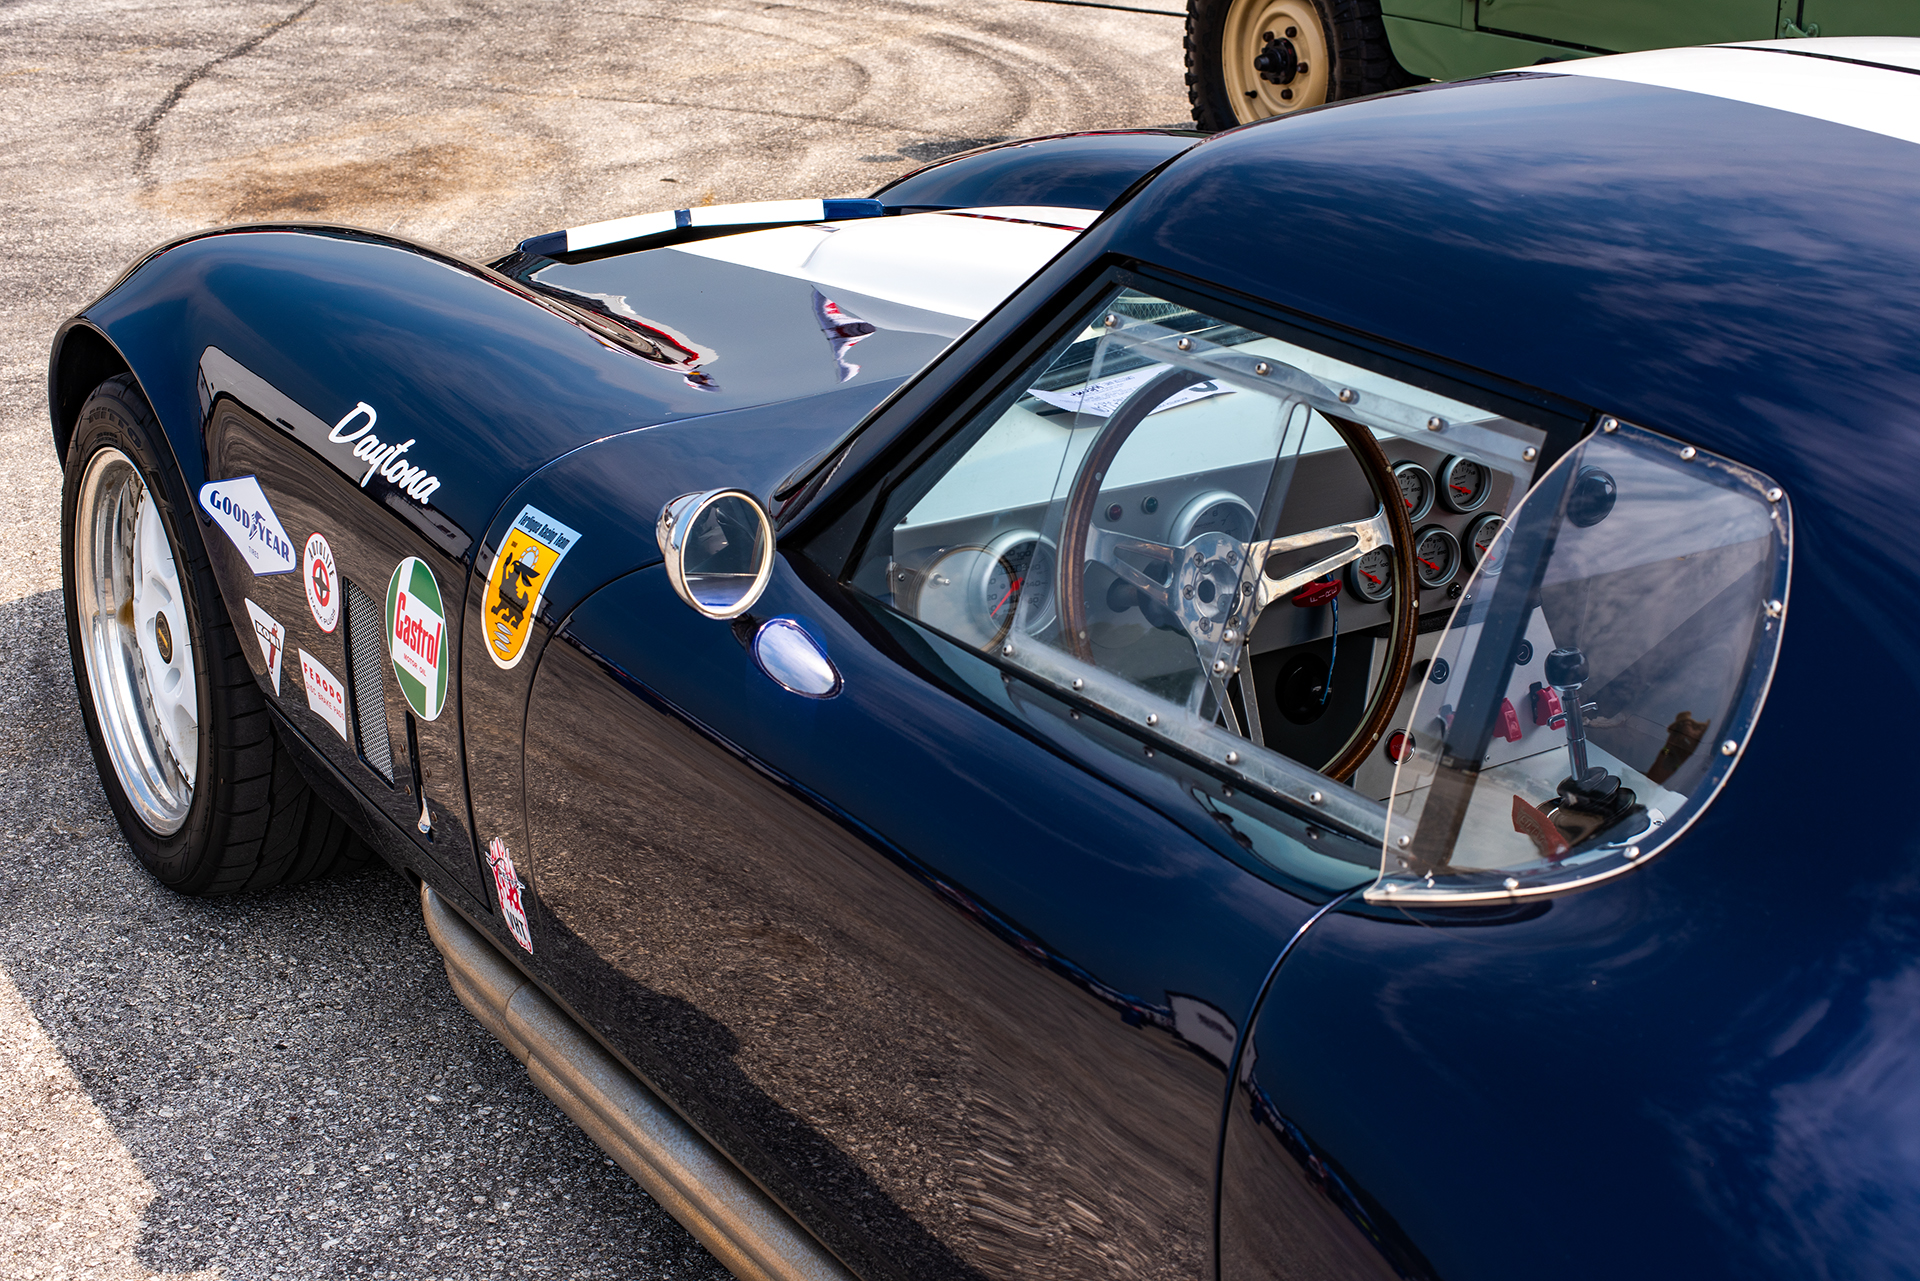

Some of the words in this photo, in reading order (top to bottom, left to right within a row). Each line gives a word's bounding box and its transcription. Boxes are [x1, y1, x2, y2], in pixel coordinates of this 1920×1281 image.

[328, 401, 441, 505] Daytona
[395, 591, 442, 670] Castrol
[303, 661, 343, 704] FERODO
